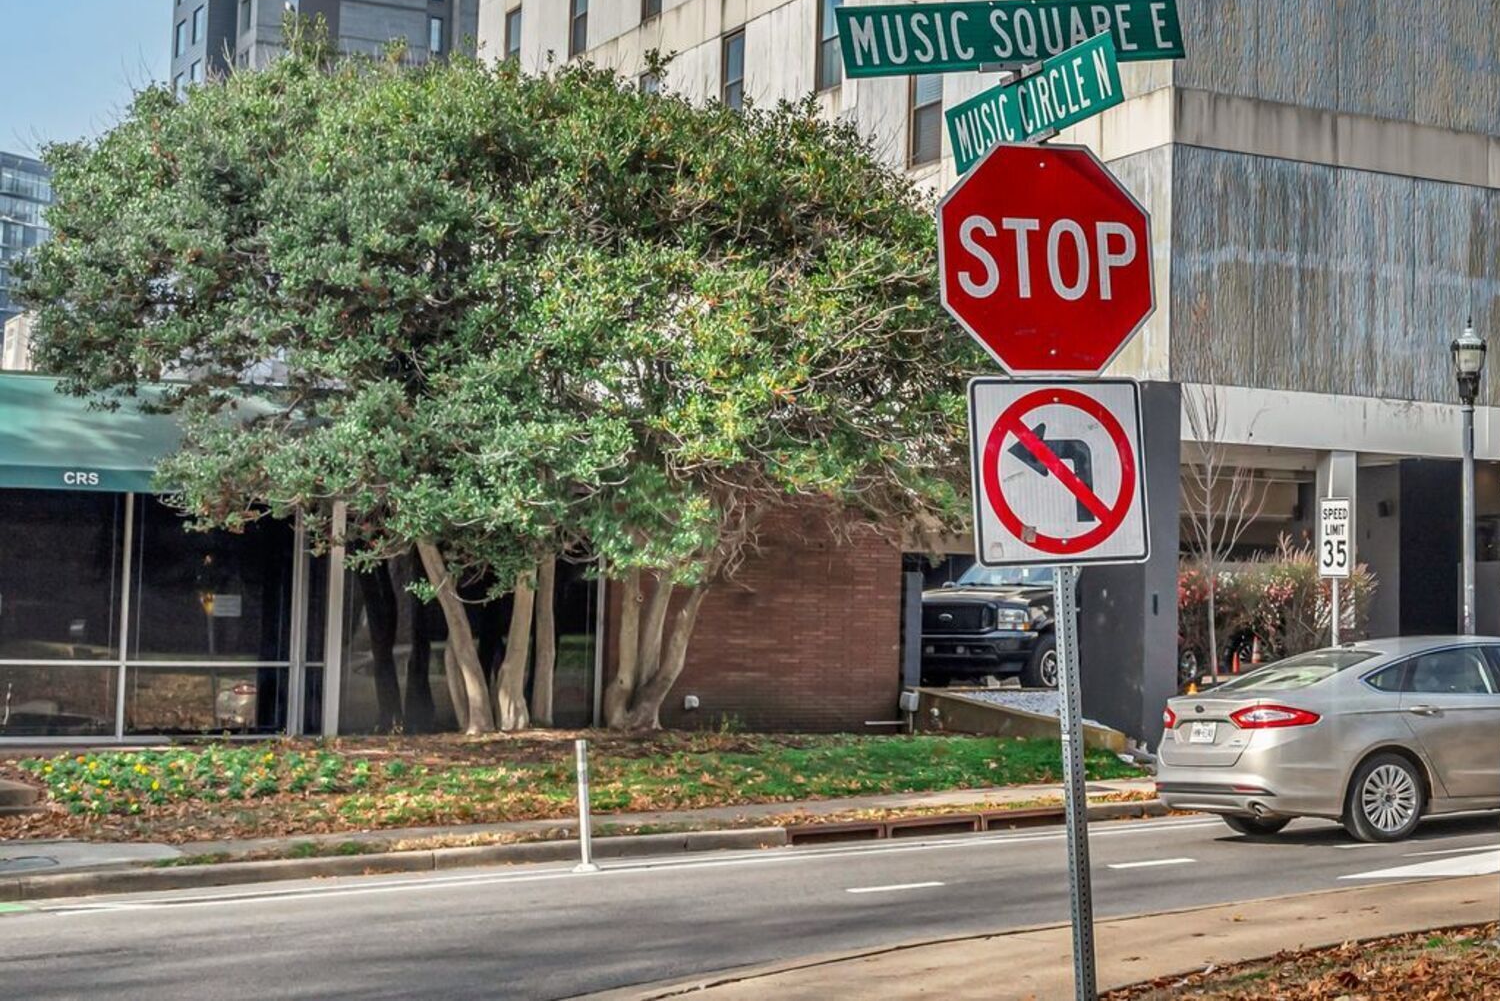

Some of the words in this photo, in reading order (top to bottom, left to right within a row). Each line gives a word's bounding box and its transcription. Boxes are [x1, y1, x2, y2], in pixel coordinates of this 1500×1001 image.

[849, 11, 975, 66] MUSIC
[989, 5, 1138, 59] SQUARE
[1150, 2, 1174, 49] E
[954, 93, 1015, 163] MUSIC
[1017, 57, 1091, 134] CIRCLE
[1092, 46, 1113, 100] N
[957, 215, 1137, 301] STOP
[63, 471, 99, 485] CRS
[1323, 508, 1348, 520] SPEED
[1325, 524, 1345, 535] LIMIT
[1323, 540, 1347, 567] 35
